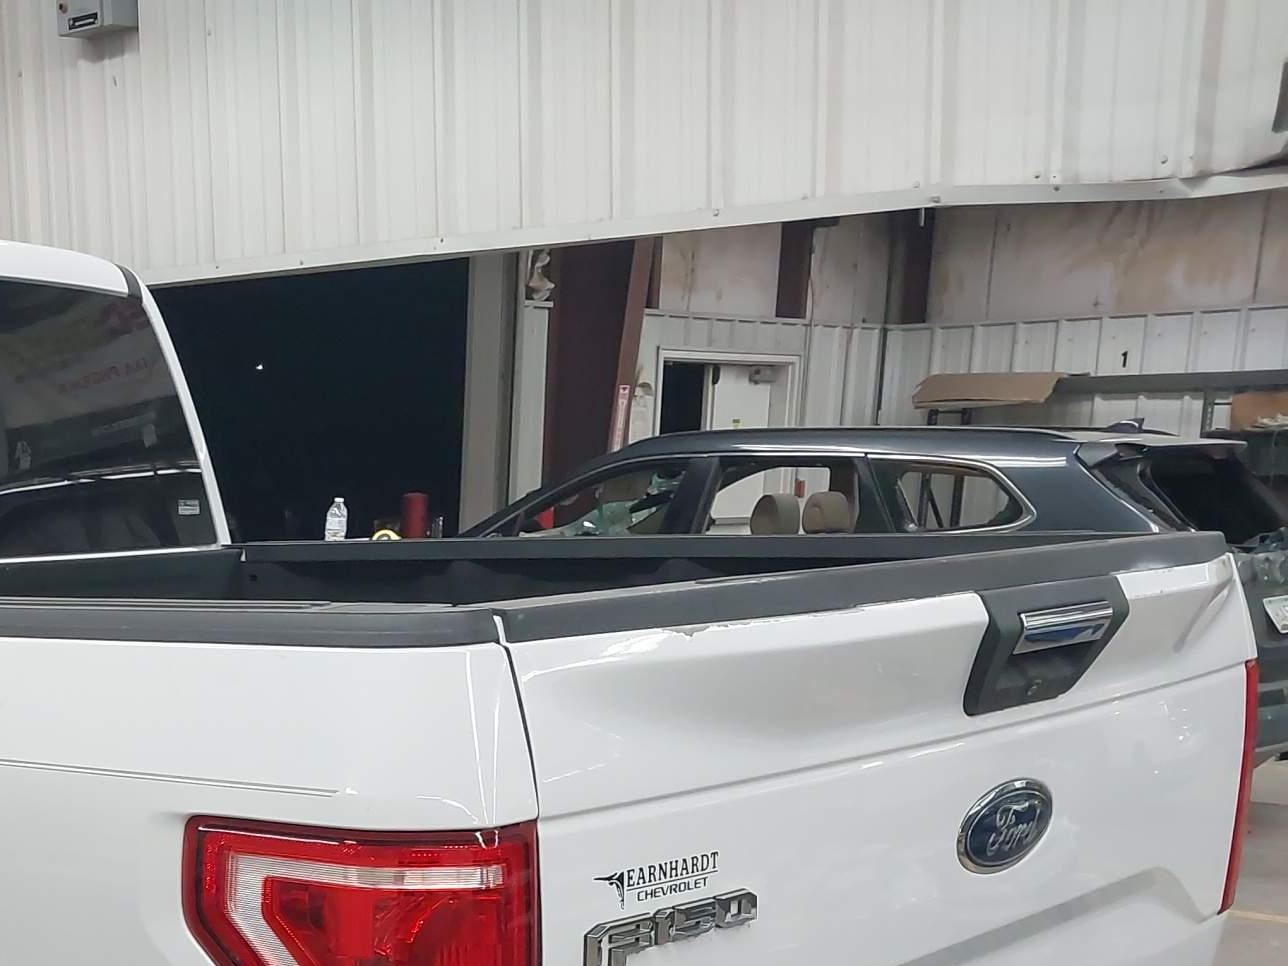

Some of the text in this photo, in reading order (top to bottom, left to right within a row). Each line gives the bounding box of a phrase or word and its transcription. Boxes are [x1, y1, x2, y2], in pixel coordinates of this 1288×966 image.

[1121, 350, 1129, 369] 1
[985, 799, 1041, 857] Ford
[626, 850, 719, 888] EARNHARDT
[636, 876, 709, 902] CHEVROLET
